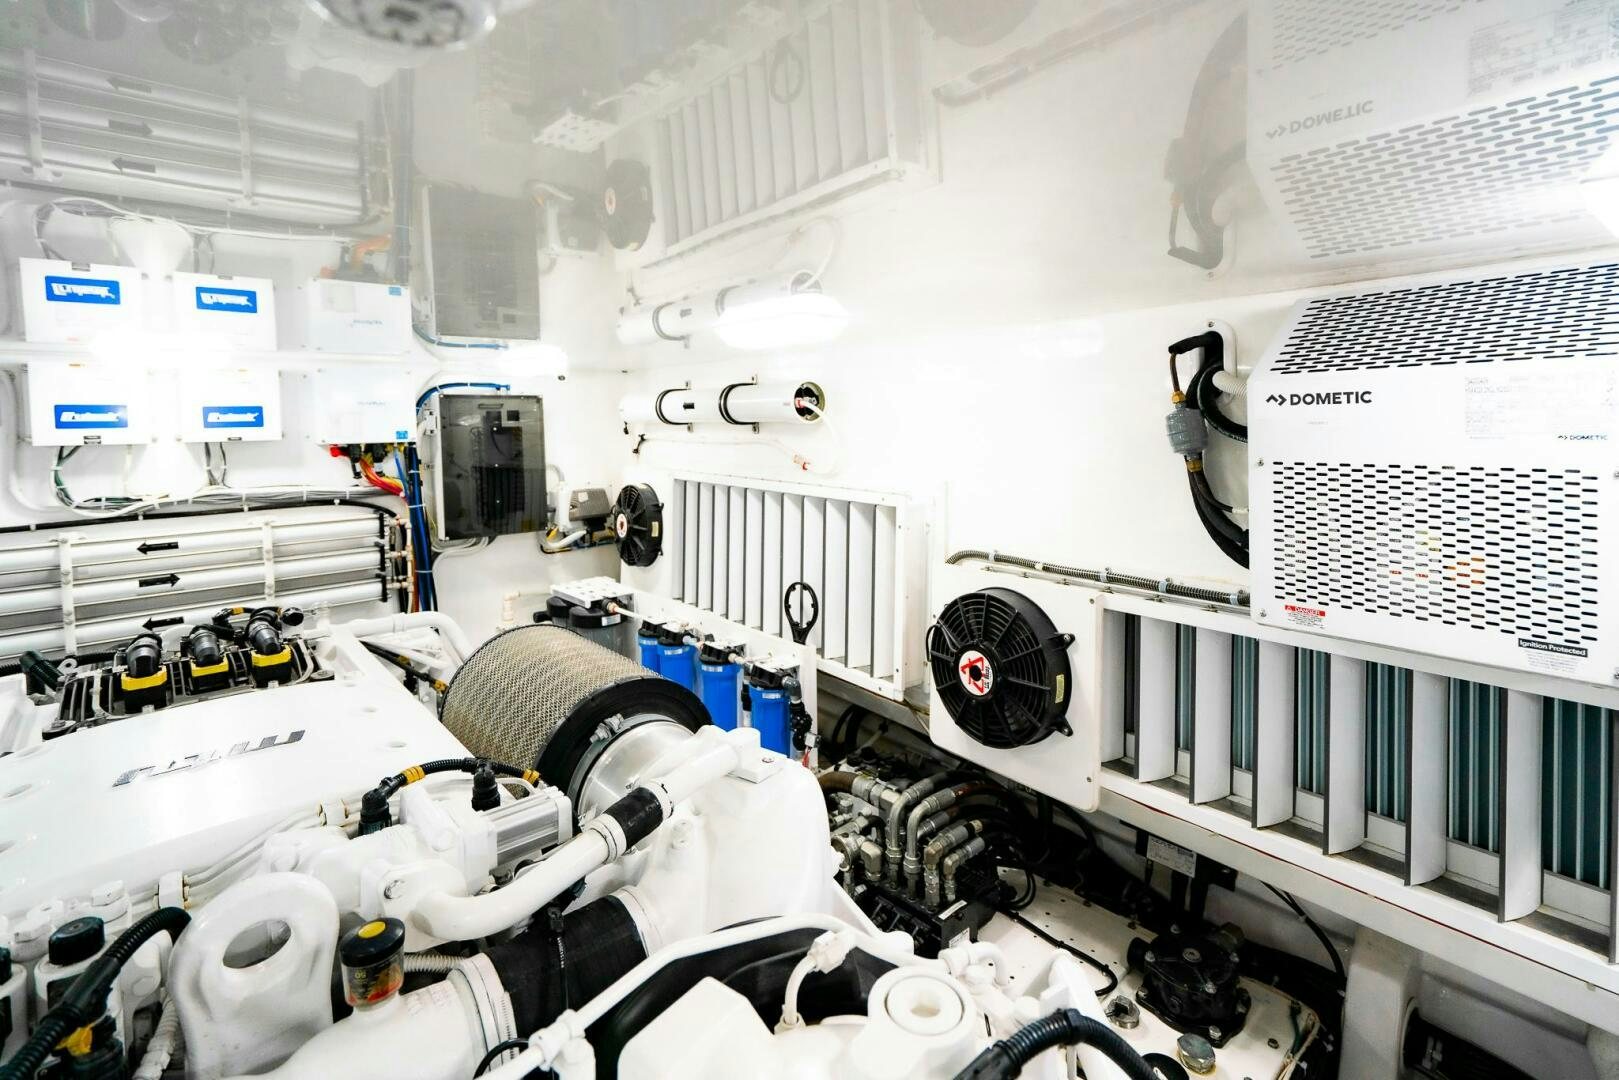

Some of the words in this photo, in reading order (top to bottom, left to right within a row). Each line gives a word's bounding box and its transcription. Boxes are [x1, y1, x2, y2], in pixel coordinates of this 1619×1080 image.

[1290, 391, 1373, 406] DOMETIC
[1519, 640, 1548, 649] Ignition
[1548, 645, 1586, 656] Protected
